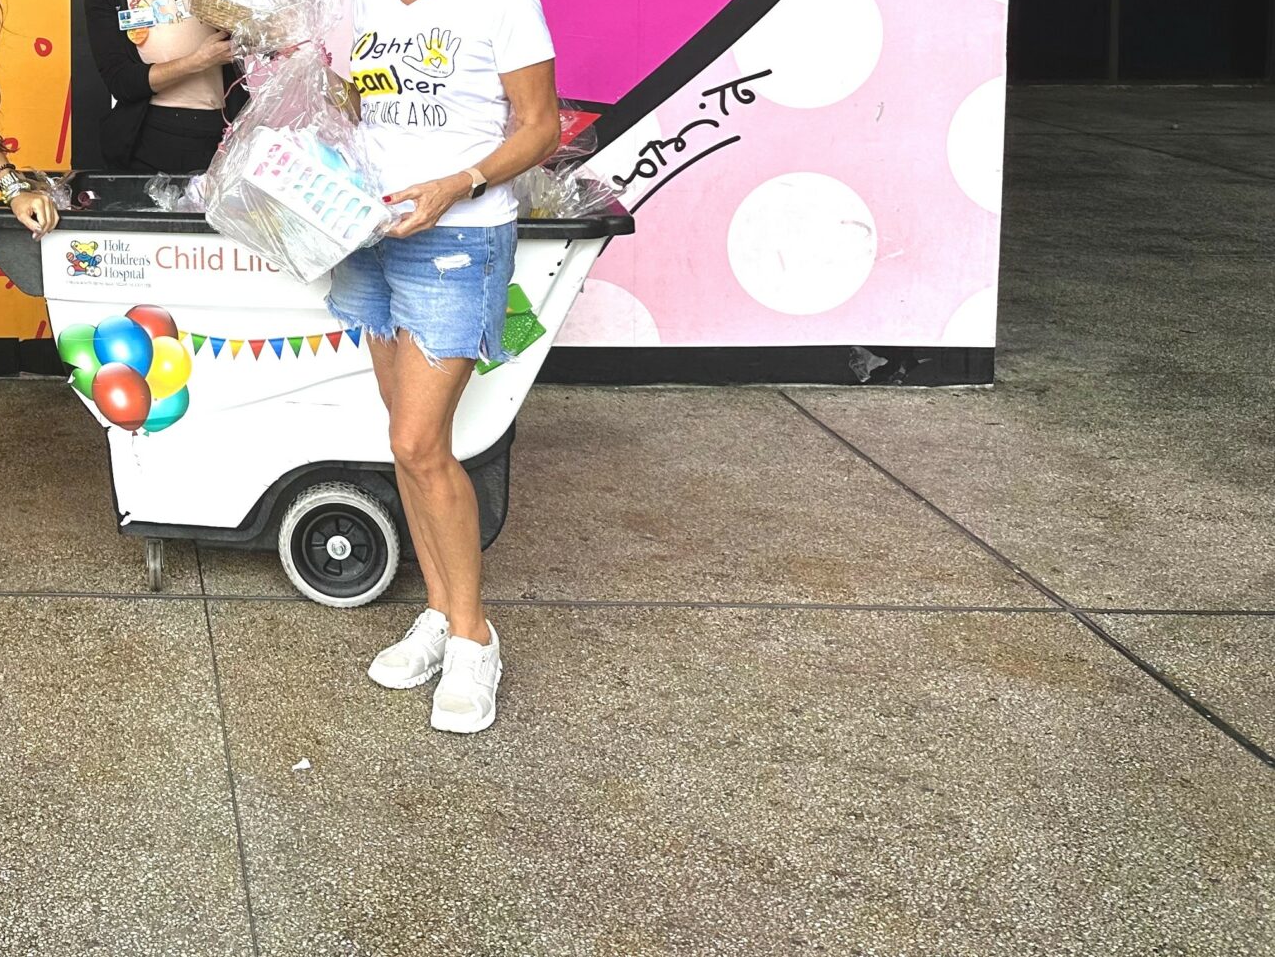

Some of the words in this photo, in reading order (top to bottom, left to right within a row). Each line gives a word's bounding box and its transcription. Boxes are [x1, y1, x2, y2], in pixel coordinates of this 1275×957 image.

[352, 64, 446, 95] can)cer
[408, 102, 418, 126] A
[422, 103, 447, 127] KID
[104, 239, 130, 252] Holtz
[104, 253, 151, 267] Children's
[155, 246, 224, 271] Child
[104, 266, 145, 282] Hospital
